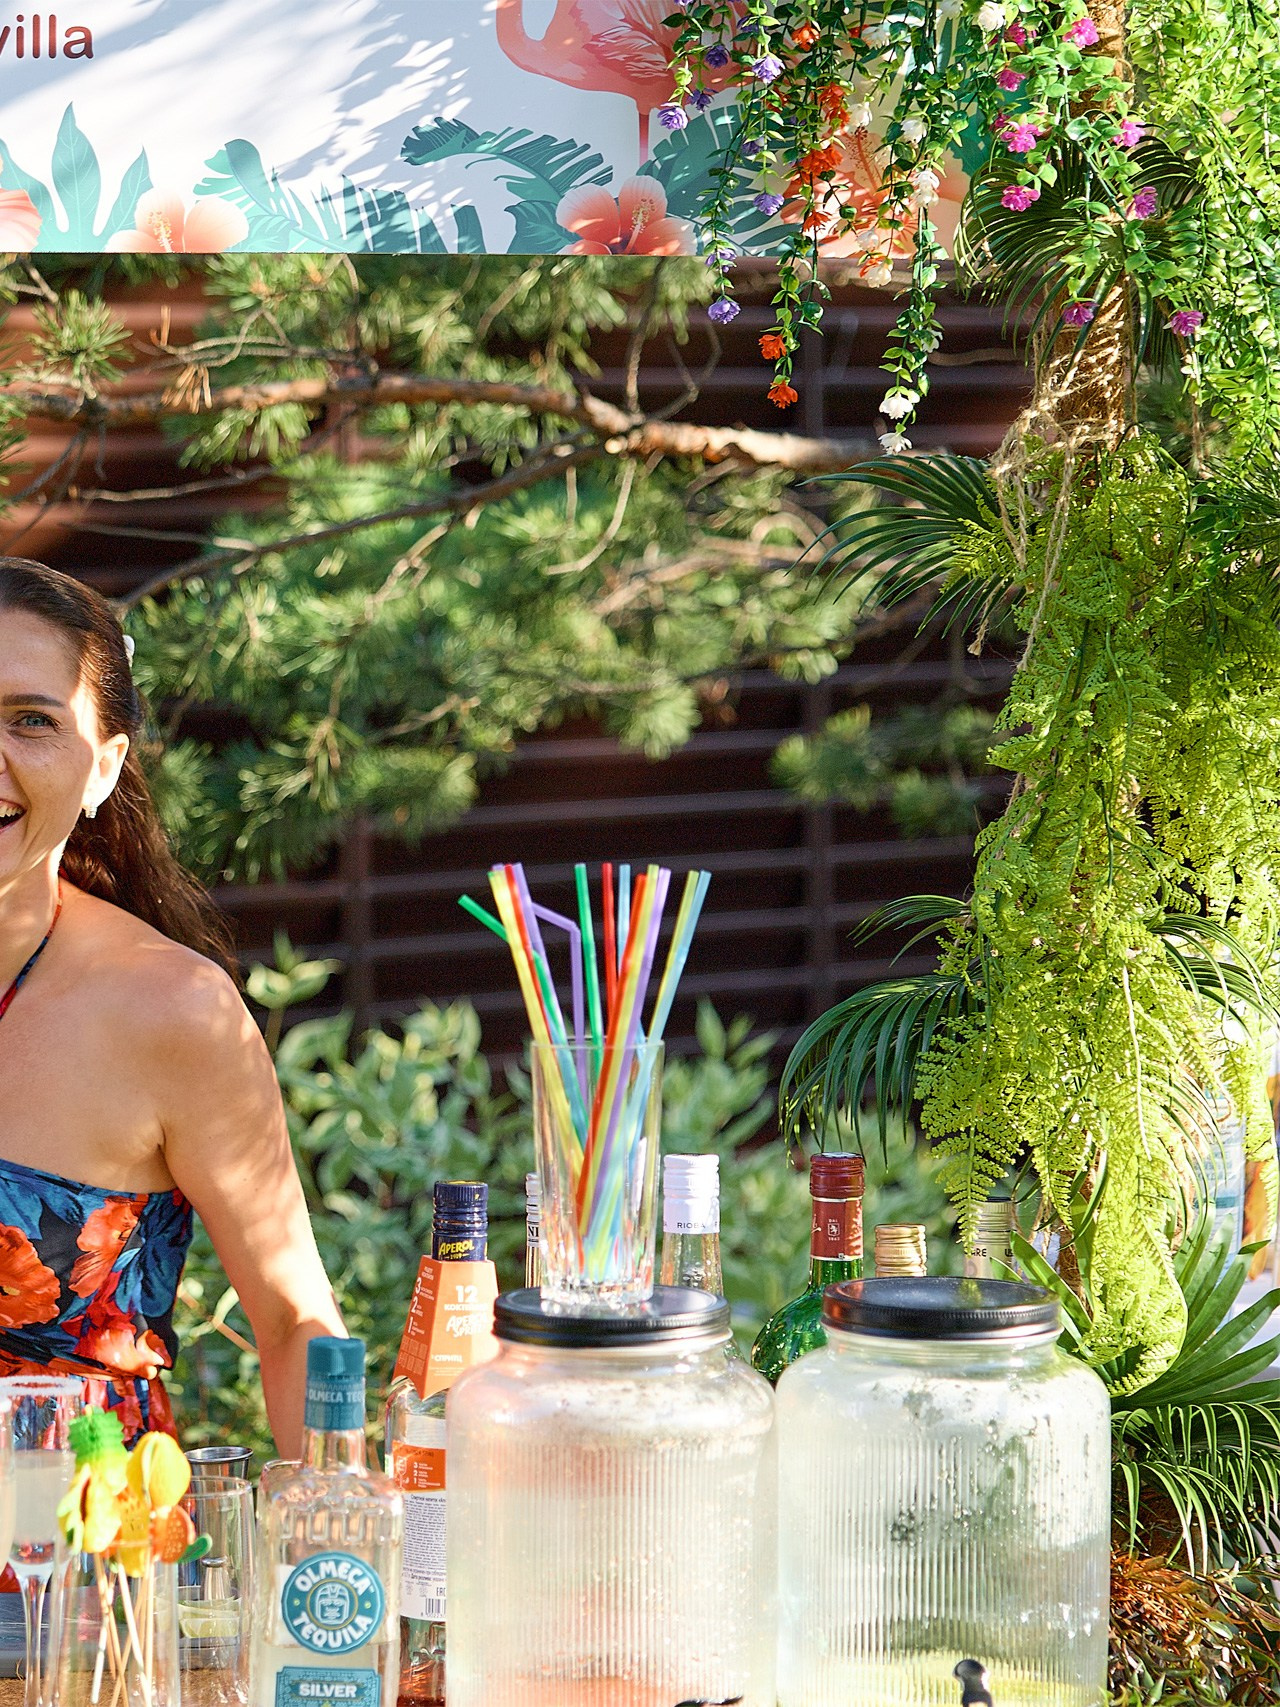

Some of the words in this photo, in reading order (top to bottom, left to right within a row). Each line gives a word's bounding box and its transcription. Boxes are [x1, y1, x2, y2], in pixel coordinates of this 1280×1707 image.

[438, 1239, 475, 1256] APEROL
[415, 1276, 422, 1294] 3
[455, 1285, 478, 1303] 12
[410, 1296, 419, 1314] 2
[309, 1389, 343, 1403] OLMECA
[295, 1560, 372, 1596] OLMECA
[293, 1611, 373, 1649] TEQUILA
[299, 1683, 357, 1698] SILVER
